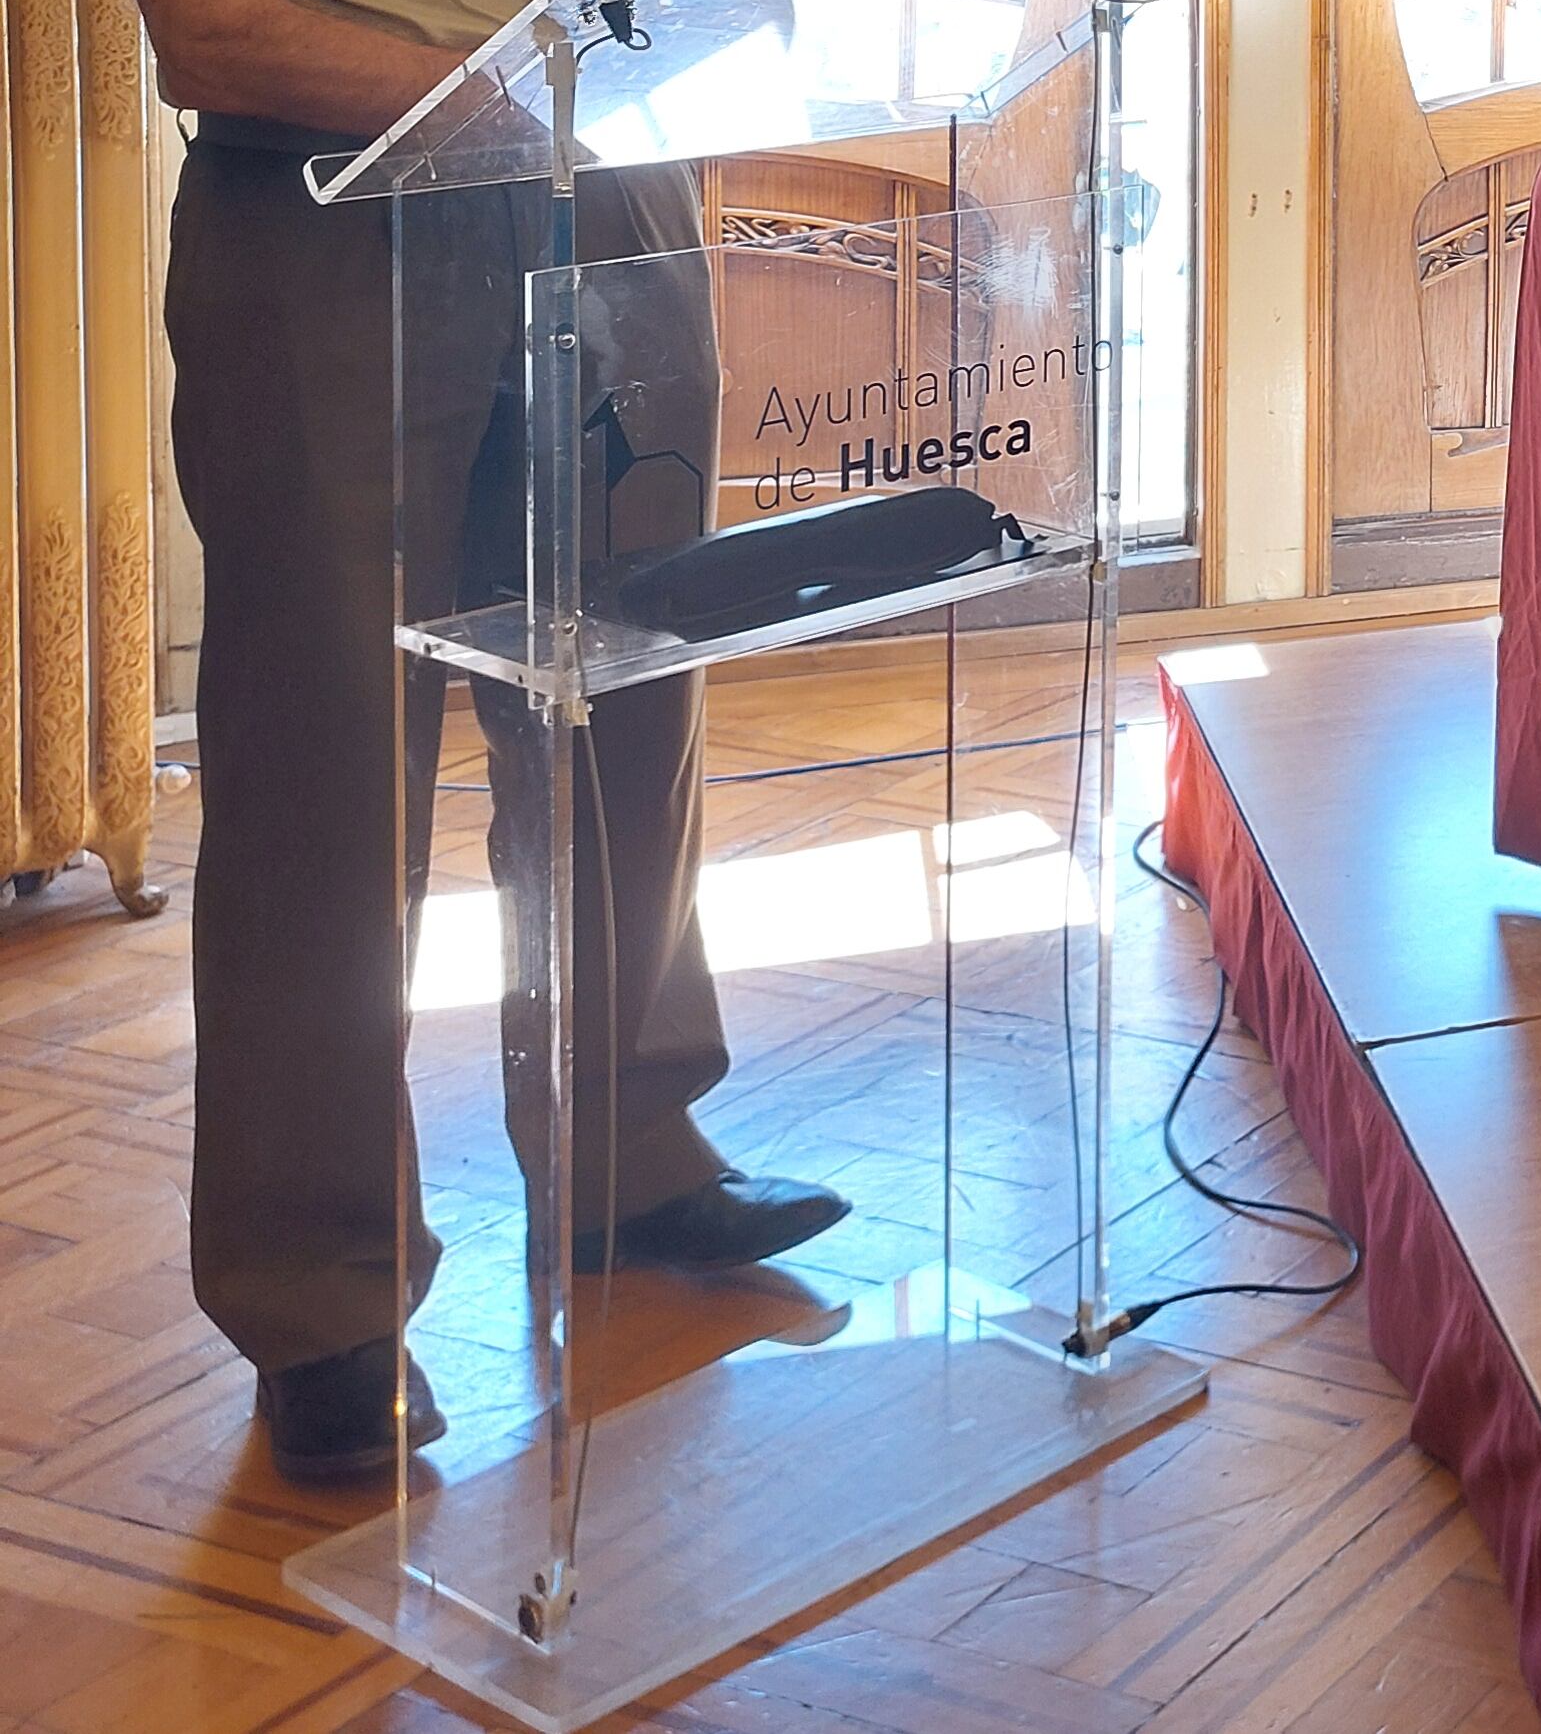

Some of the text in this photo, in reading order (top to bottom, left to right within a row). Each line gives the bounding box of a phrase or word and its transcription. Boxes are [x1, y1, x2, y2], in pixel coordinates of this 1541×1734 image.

[754, 333, 1114, 448] Ayuntamiento
[754, 418, 1032, 511] de Huesca
